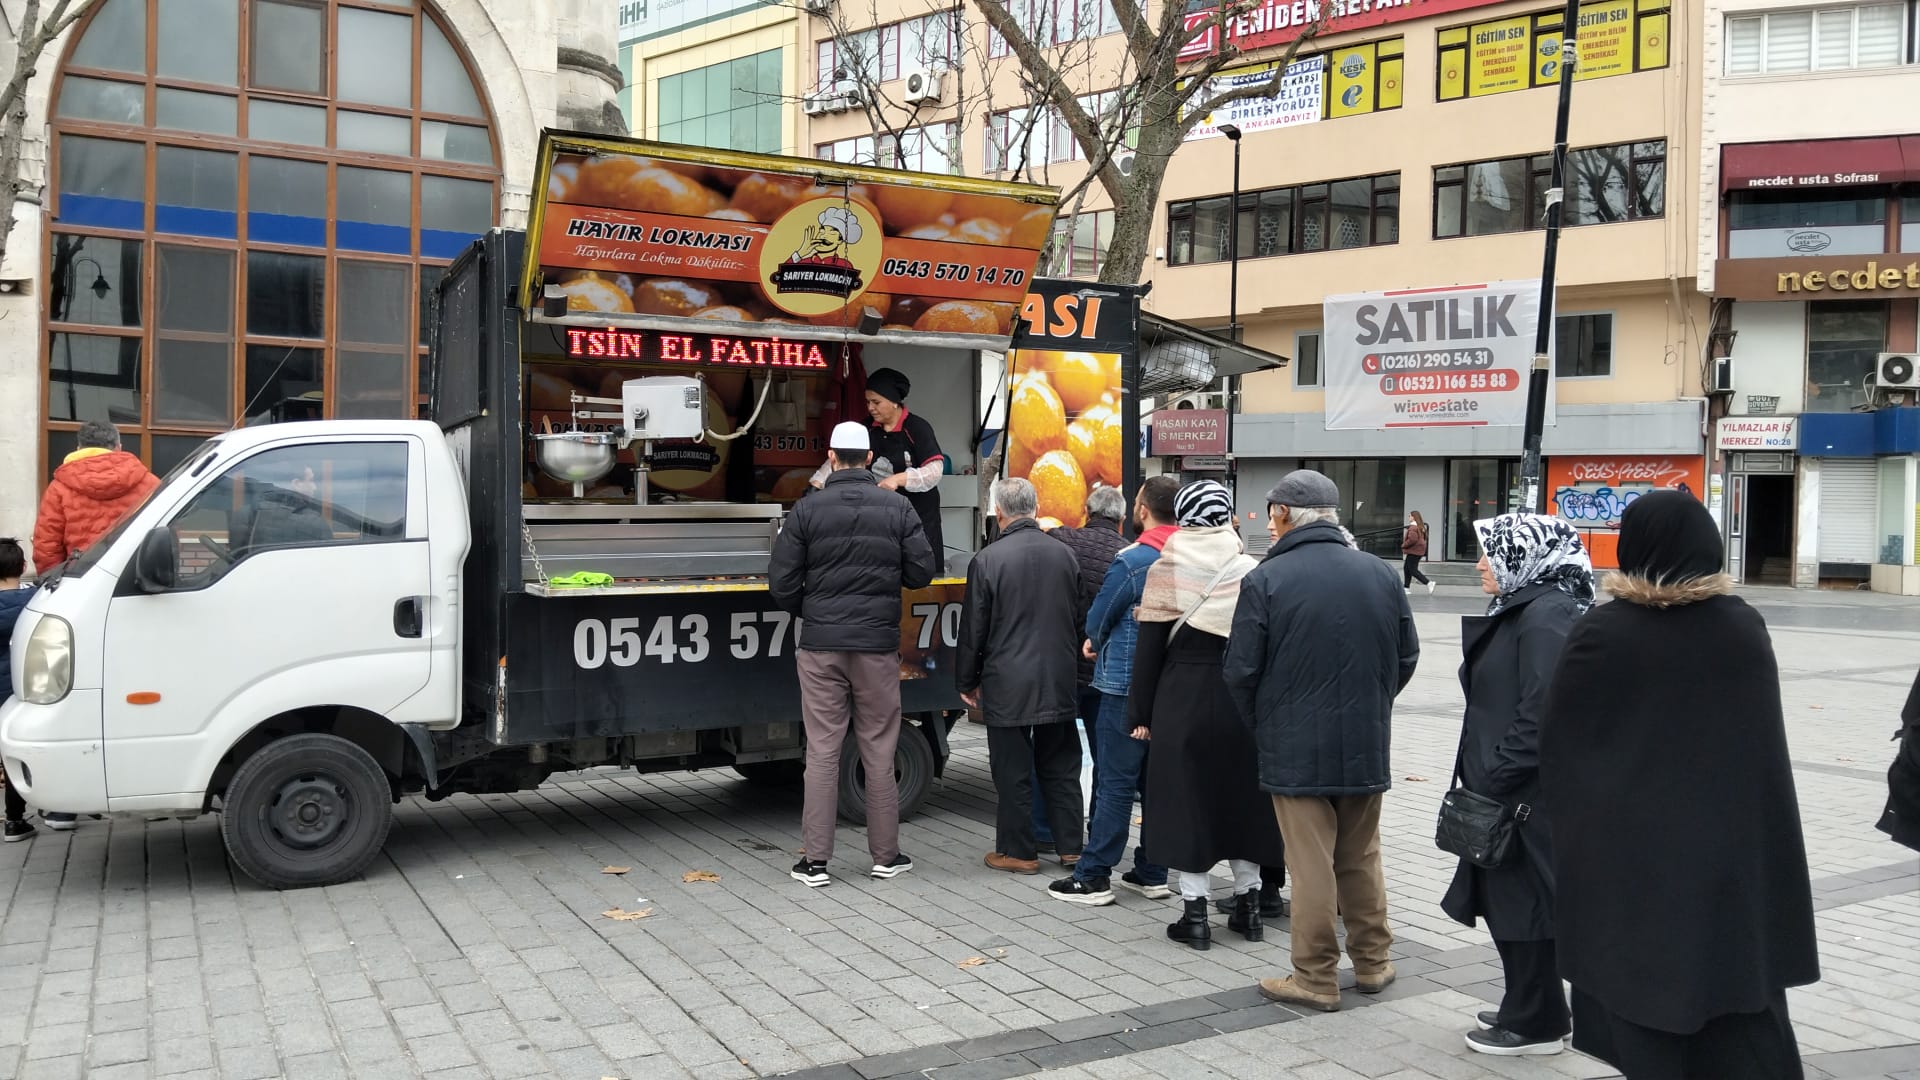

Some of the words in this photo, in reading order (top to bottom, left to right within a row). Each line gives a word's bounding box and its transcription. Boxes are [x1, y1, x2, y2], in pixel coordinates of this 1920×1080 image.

[1610, 8, 1628, 22] SEN
[1476, 29, 1506, 45] EĞİTİM
[1508, 26, 1525, 40] SEN
[1340, 62, 1367, 75] KESK
[1291, 73, 1319, 86] KARŞI
[1748, 177, 1794, 187] necdet
[1799, 175, 1829, 185] usta
[1834, 173, 1879, 183] Sofrası
[566, 218, 643, 243] HAYIR
[648, 226, 753, 253] LOKMASI
[573, 244, 637, 261] Hayırlara
[639, 251, 682, 266] Lokma
[783, 271, 815, 281] SARIYER
[883, 258, 931, 278] 0543
[934, 263, 970, 282] 570
[975, 265, 999, 285] 14
[1001, 268, 1025, 287] 70
[1777, 261, 1920, 292] necdet
[1355, 294, 1518, 346] SATILIK
[567, 326, 642, 358] TSİN
[660, 336, 702, 361] EL
[711, 336, 828, 367] FATİHA
[1381, 353, 1421, 370] (0216)
[1423, 352, 1451, 368] 290
[1453, 351, 1472, 366] 54
[1475, 350, 1488, 365] 31
[1399, 374, 1441, 392] (0532)
[1444, 375, 1466, 389] 166
[1470, 374, 1486, 388] 55
[1490, 373, 1507, 388] 88
[1394, 399, 1478, 413] winvestate
[1155, 419, 1188, 429] HASAN
[1191, 419, 1218, 428] KAYA
[1722, 423, 1779, 432] YILMAZLAR
[777, 436, 806, 450] 570
[1721, 436, 1763, 446] MERKEZİ
[573, 613, 709, 669] 0543
[729, 610, 801, 660] 57
[911, 602, 962, 649] 70
